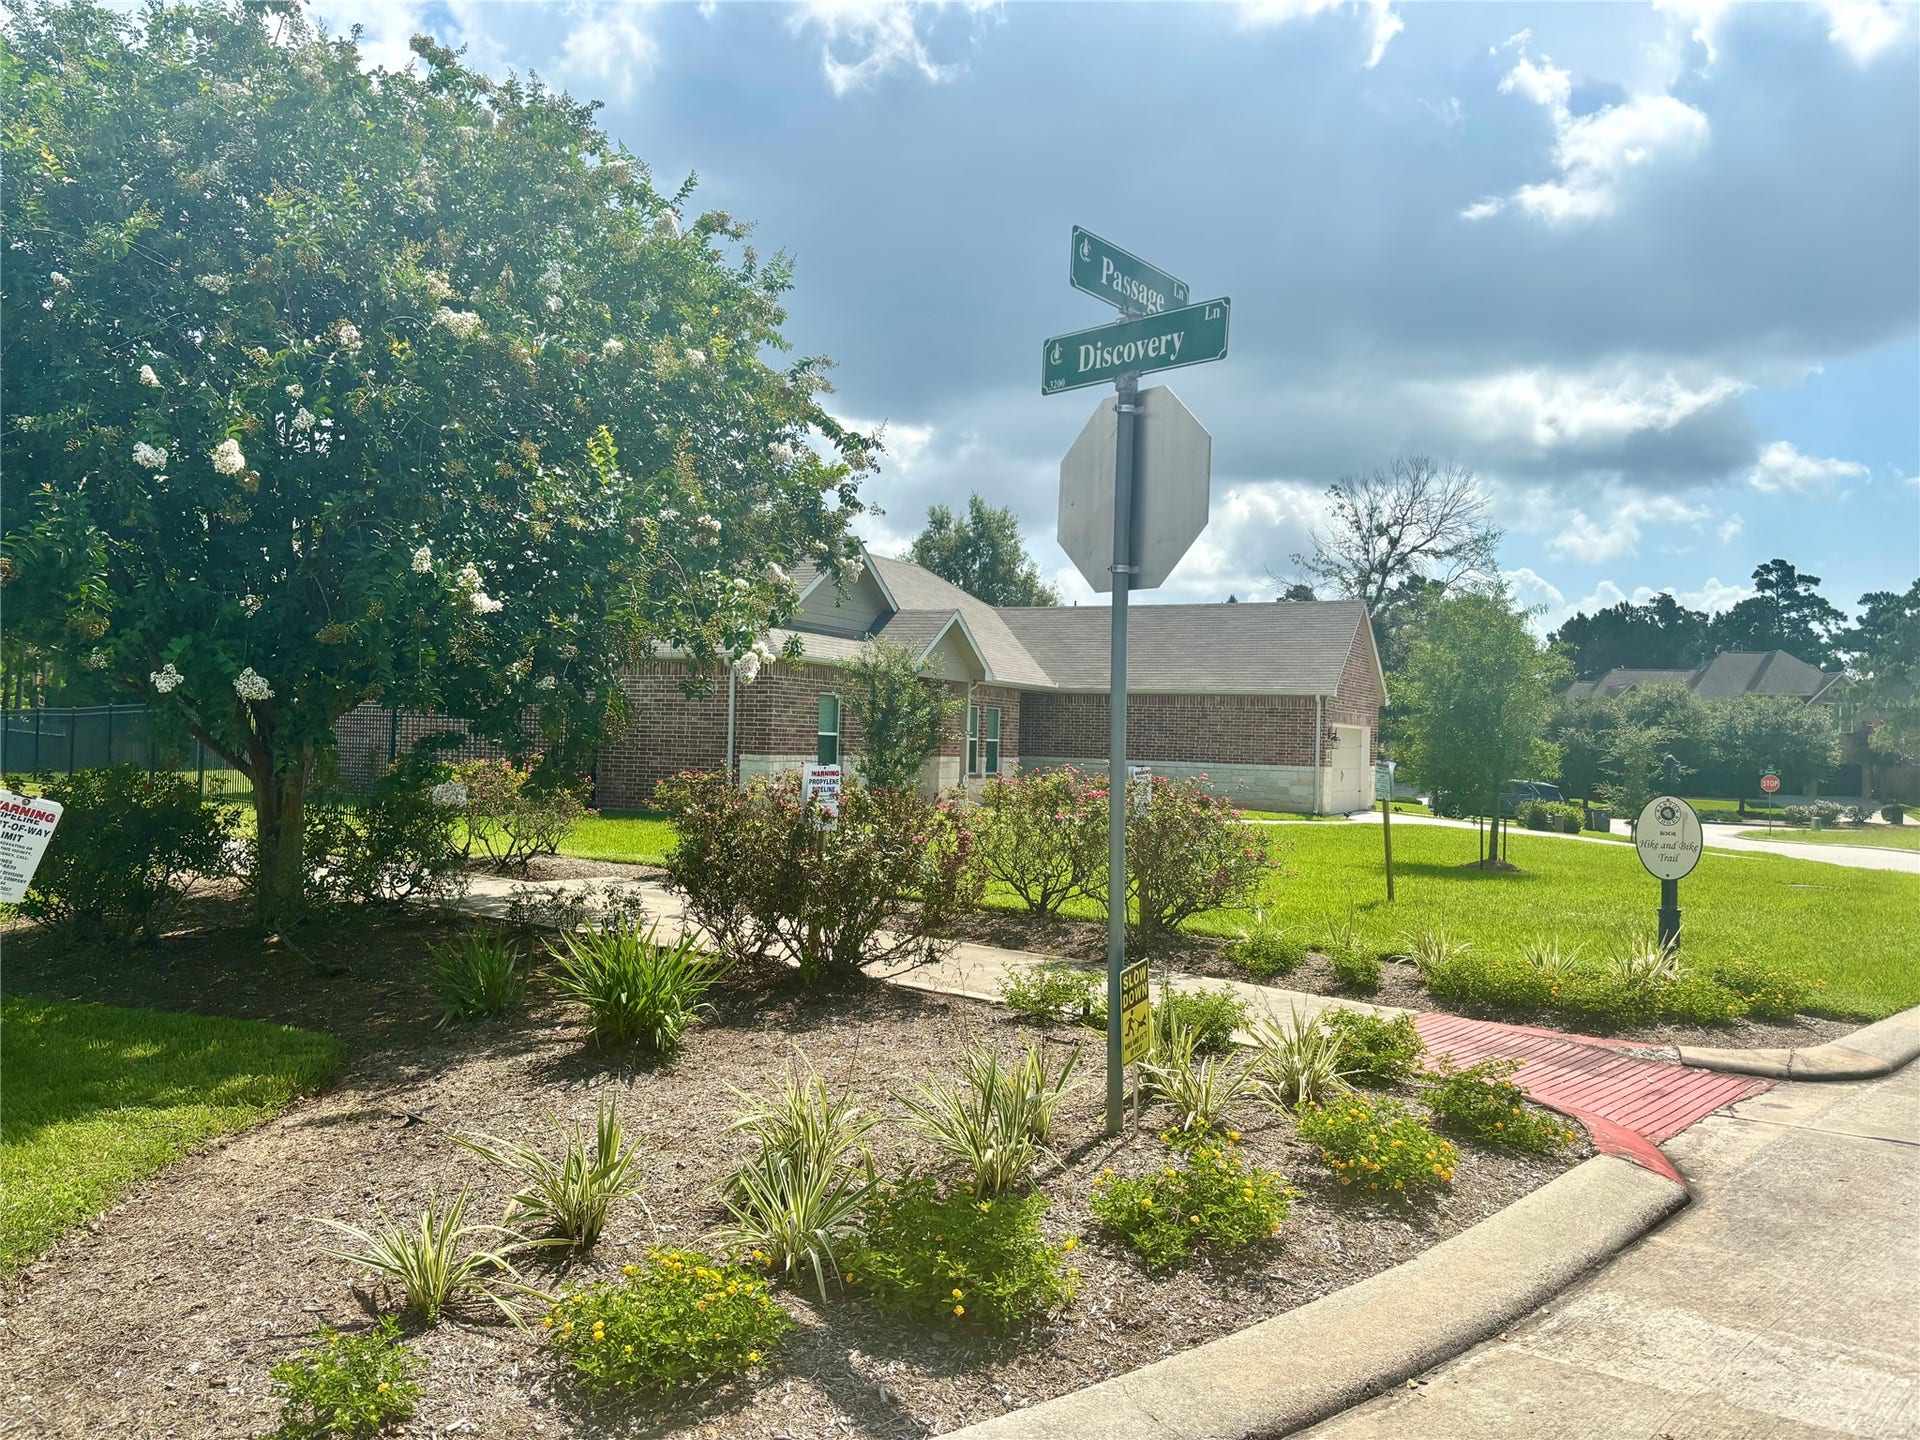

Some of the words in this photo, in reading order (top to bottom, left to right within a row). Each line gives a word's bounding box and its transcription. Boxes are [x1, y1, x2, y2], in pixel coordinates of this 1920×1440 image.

[1101, 256, 1164, 315] Passage
[1173, 282, 1184, 301] Ln
[1078, 331, 1185, 373] Discovery
[1205, 306, 1220, 321] Ln
[0, 800, 56, 823] ARNING
[0, 811, 40, 826] IPELINE
[0, 820, 51, 838] T-OF-WAY
[1, 831, 24, 842] IMIT
[1639, 840, 1659, 851] Hike
[1661, 840, 1678, 850] and
[1679, 841, 1699, 853] Bike
[1658, 853, 1680, 862] Trail
[1123, 965, 1147, 991] SLOW
[1123, 982, 1147, 1009] DOWN
